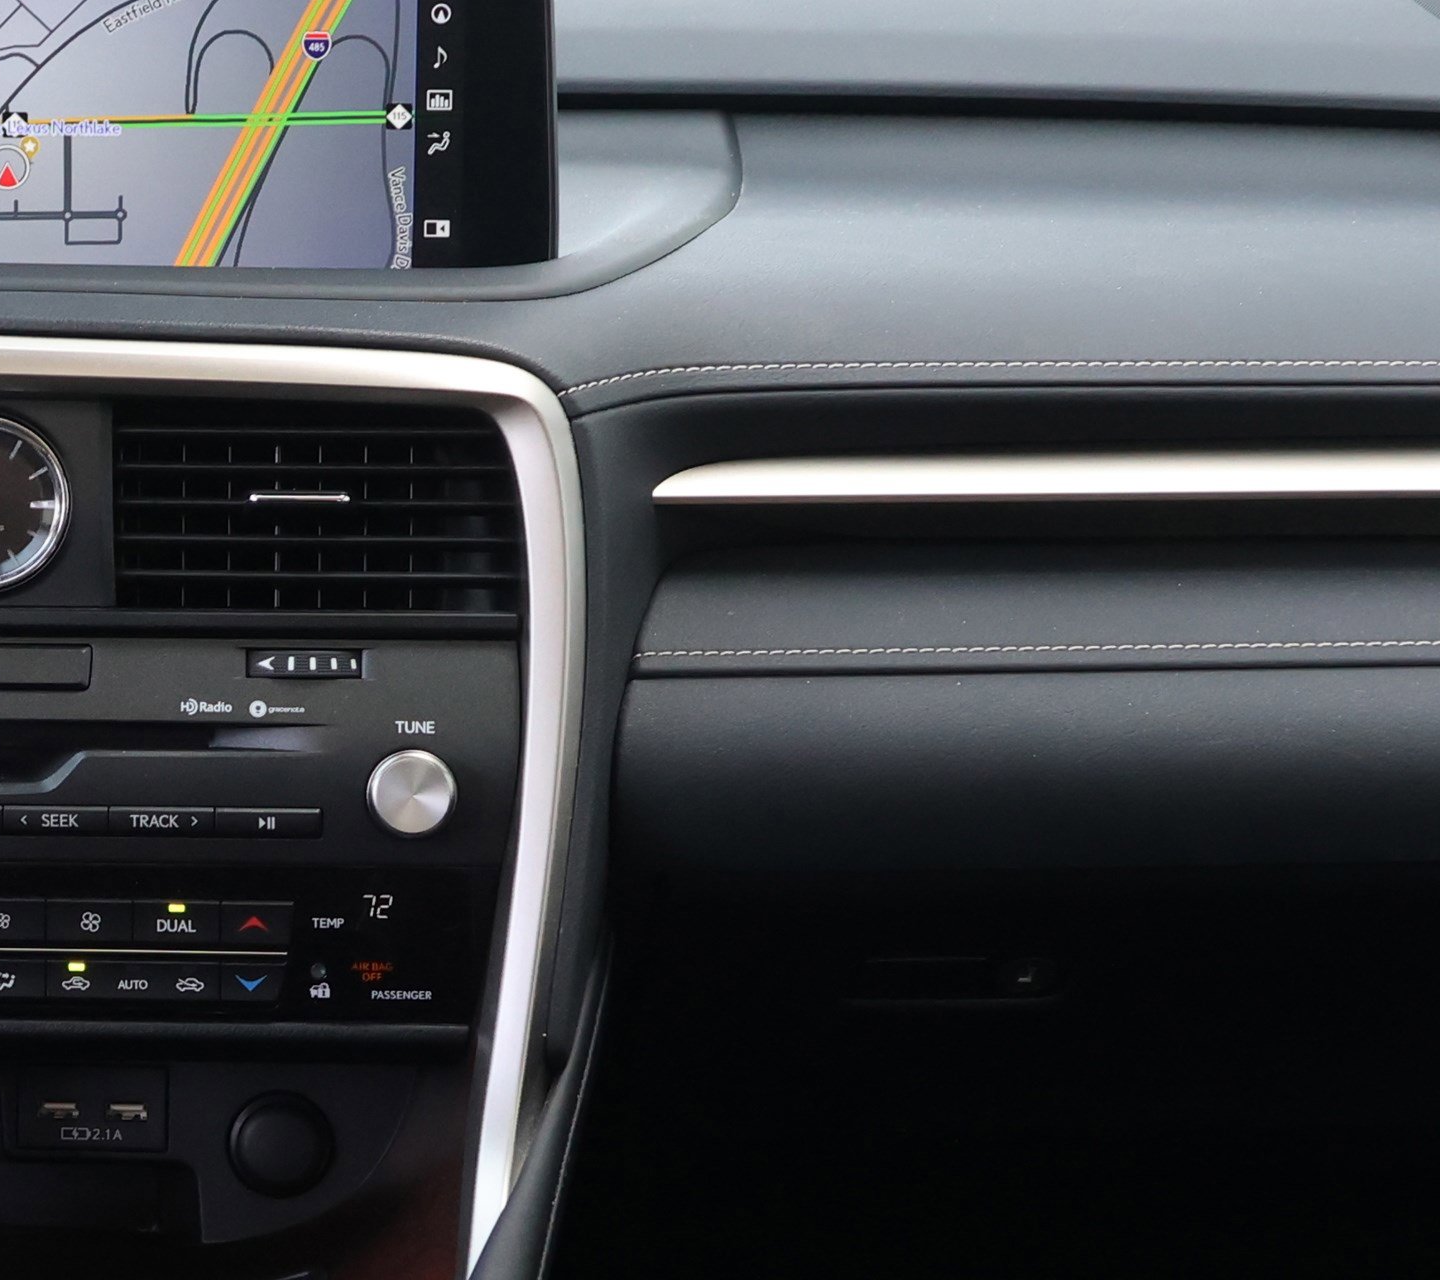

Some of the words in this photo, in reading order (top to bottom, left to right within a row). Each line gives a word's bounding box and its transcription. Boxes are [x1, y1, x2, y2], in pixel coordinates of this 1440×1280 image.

[308, 42, 325, 53] 485
[8, 121, 47, 134] Lexus
[51, 121, 121, 134] Northlake
[390, 167, 406, 211] Vance
[397, 214, 412, 255] Davis
[199, 701, 232, 713] Radio
[395, 720, 435, 734] TUNE
[41, 814, 79, 828] SEEK
[130, 814, 179, 828] TRACK
[363, 894, 393, 919] 72
[156, 919, 196, 933] DUAL
[312, 918, 344, 929] TEMP
[351, 962, 369, 972] AIR
[371, 962, 393, 972] BAG
[361, 972, 382, 982] OFF
[118, 979, 148, 990] AUTO
[371, 990, 432, 1001] PASSENGER
